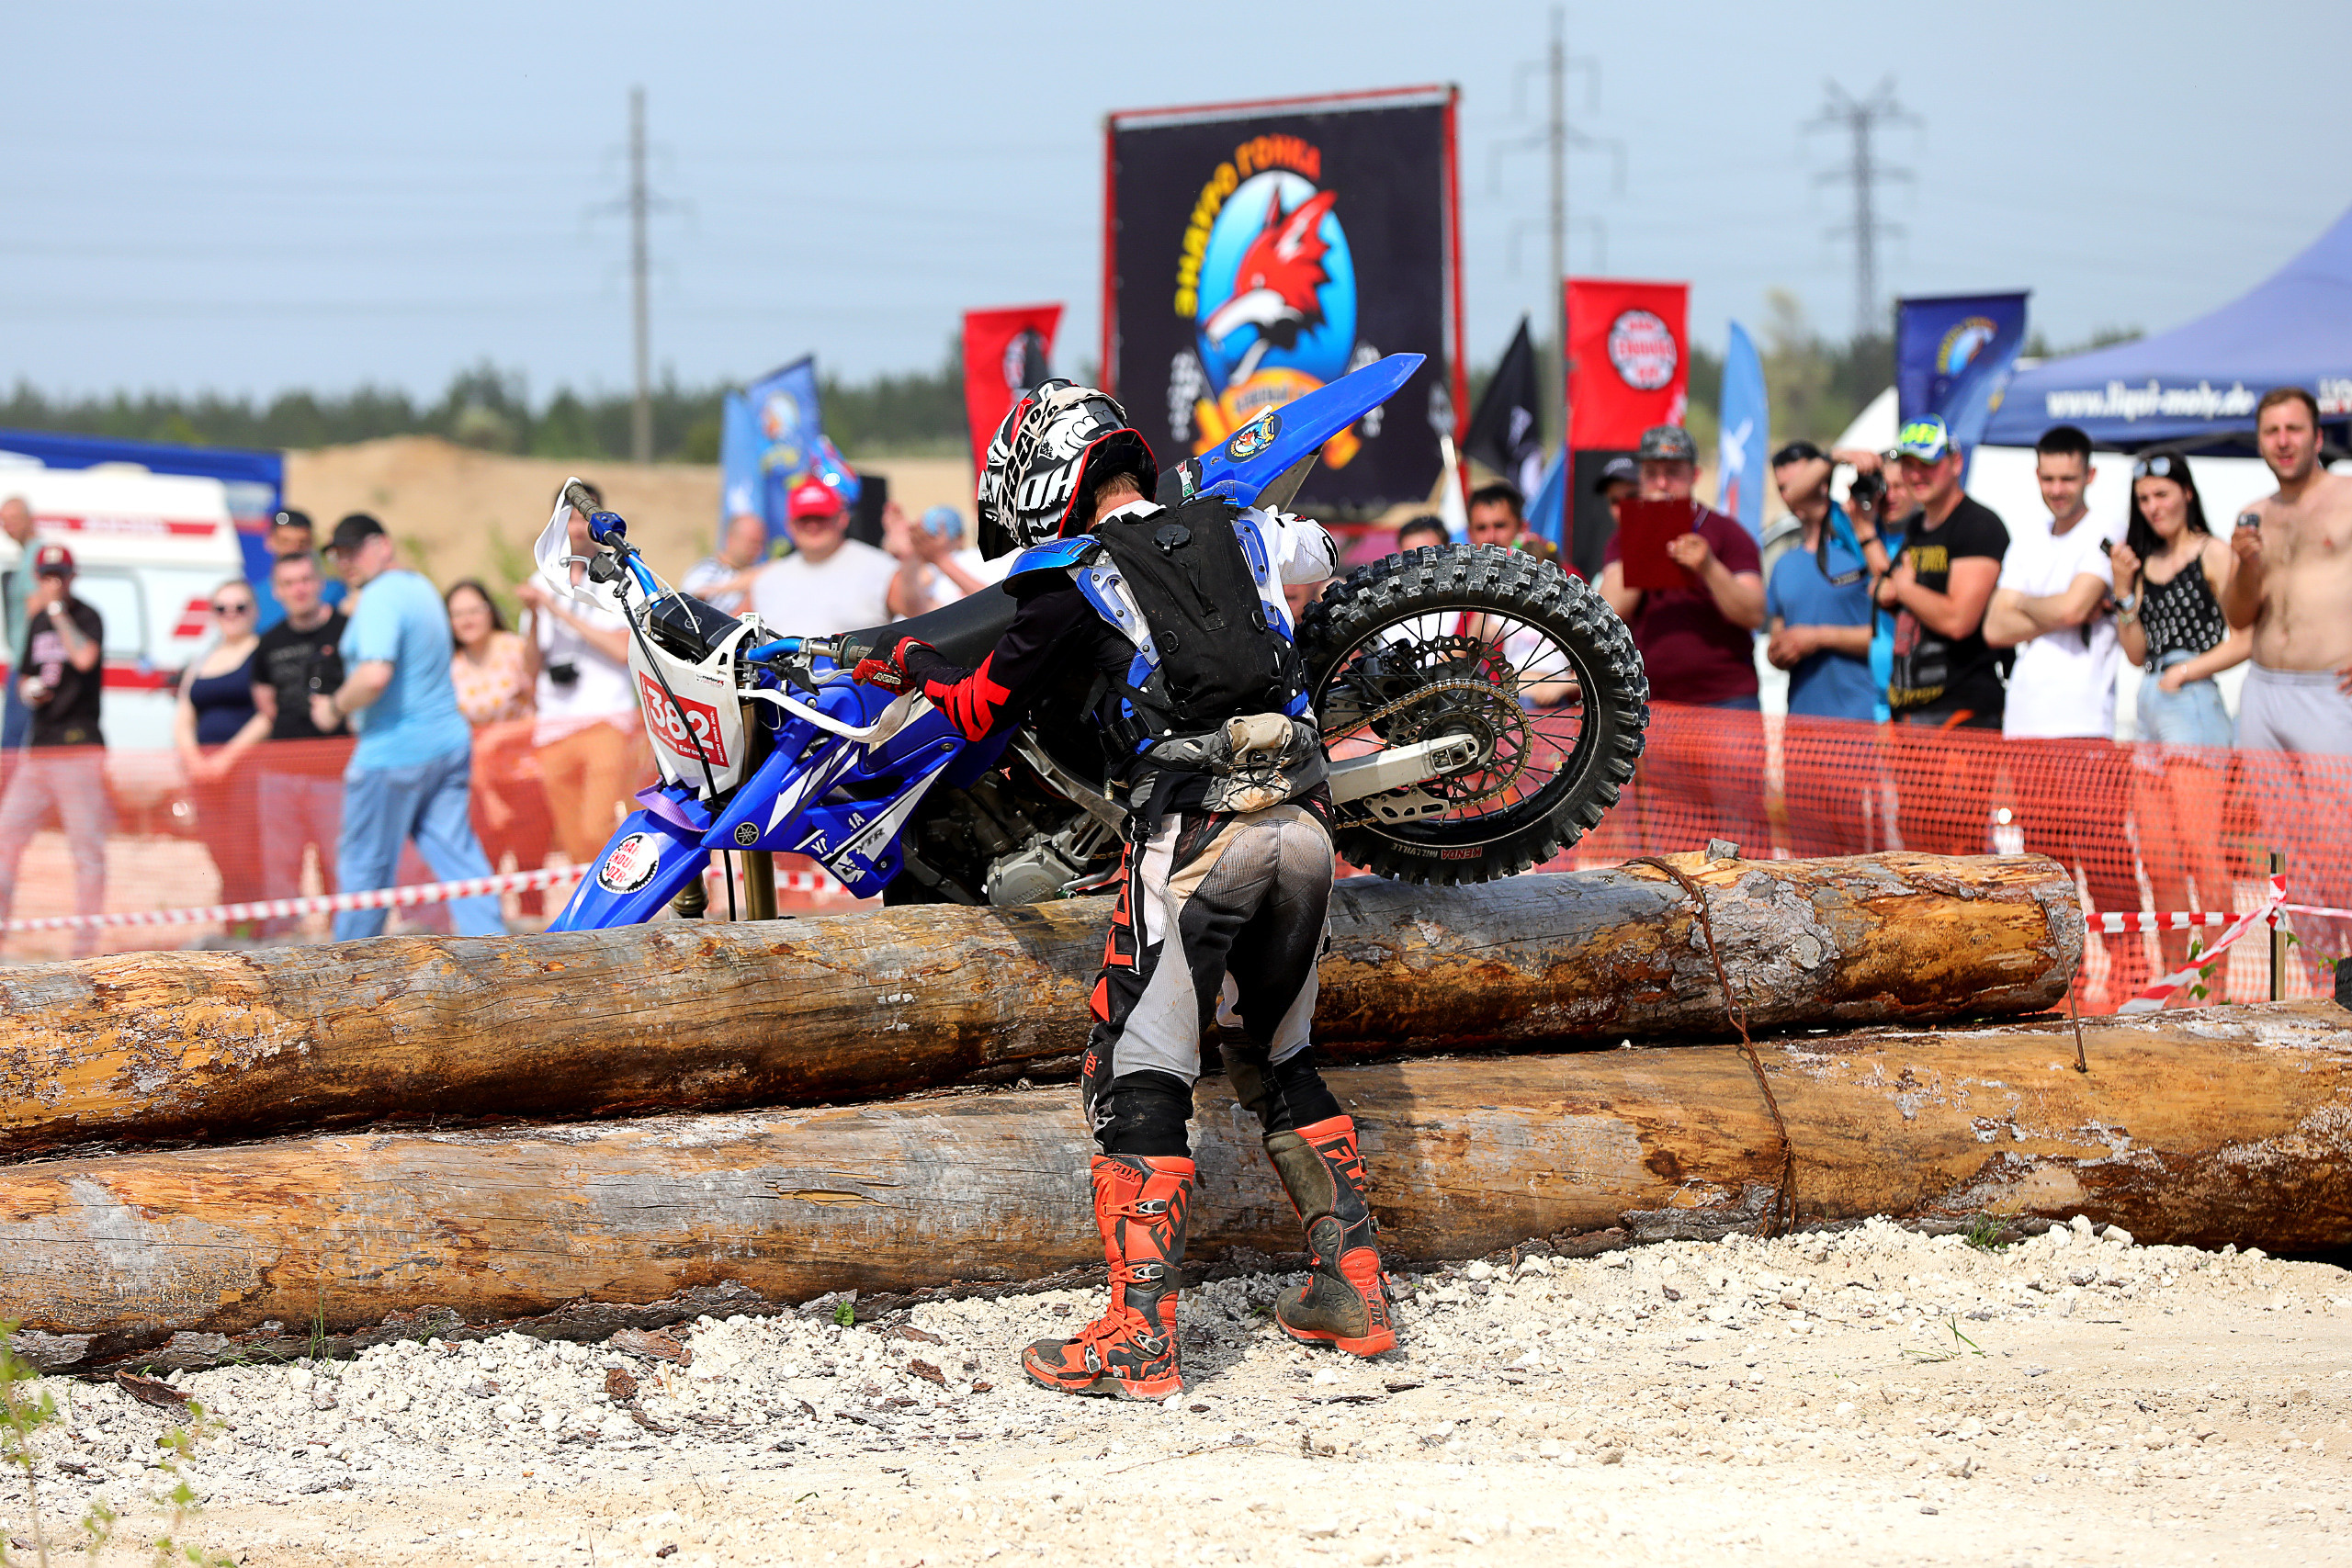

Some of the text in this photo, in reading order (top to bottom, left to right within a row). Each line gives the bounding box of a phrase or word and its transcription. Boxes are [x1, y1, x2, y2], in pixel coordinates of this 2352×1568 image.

[2045, 378, 2256, 423] www.liqui-moly.de
[646, 685, 715, 750] 382
[678, 744, 711, 760] Евгенй
[1390, 842, 1483, 860] KENDA MILLVILLE
[605, 865, 627, 883] DZR
[1084, 1051, 1098, 1077] FOX
[1113, 1163, 1141, 1182] FOX
[1368, 1299, 1385, 1327] FOX
